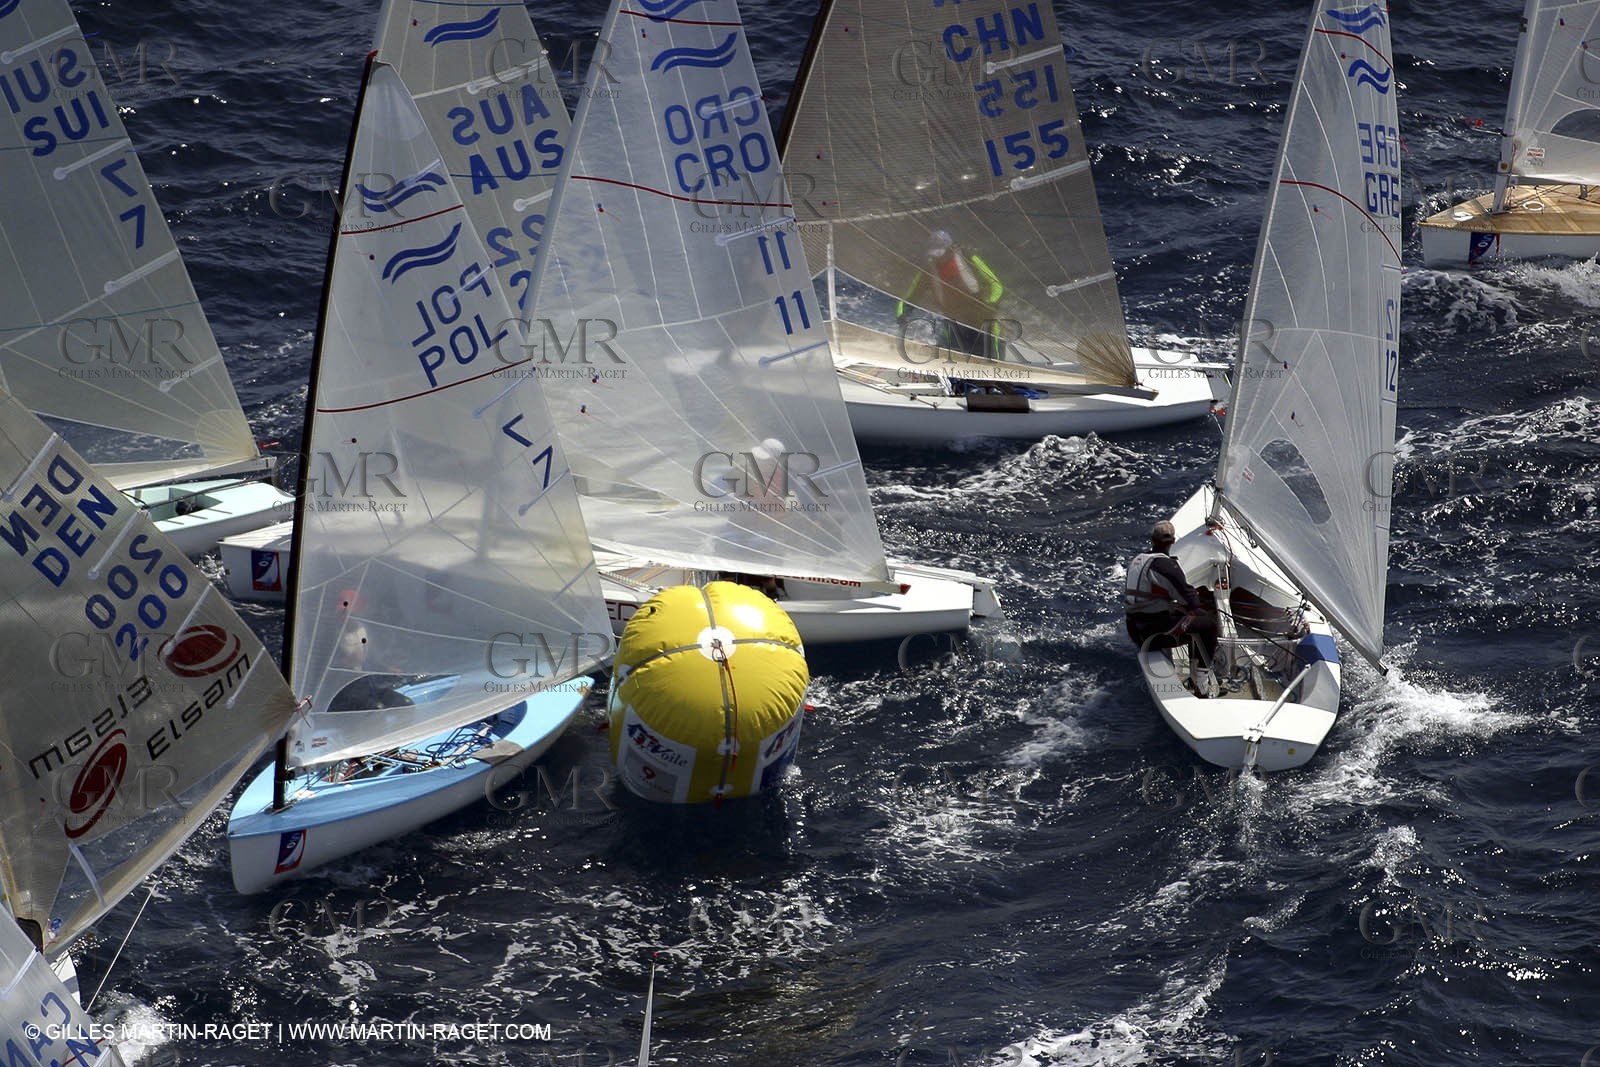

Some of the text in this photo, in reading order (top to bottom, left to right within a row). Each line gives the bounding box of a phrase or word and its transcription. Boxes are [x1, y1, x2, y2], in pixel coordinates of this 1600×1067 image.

[943, 3, 1045, 62] CHN
[24, 90, 110, 157] SUI
[985, 119, 1070, 177] 155
[469, 128, 565, 195] AUS
[674, 132, 771, 193] CRO
[1365, 172, 1400, 219] GRE
[119, 204, 146, 250] 7
[774, 290, 811, 336] 11
[418, 313, 509, 388] POL
[1385, 348, 1398, 393] 12
[532, 445, 554, 491] 7
[32, 484, 119, 588] DEN
[114, 564, 189, 662] 200
